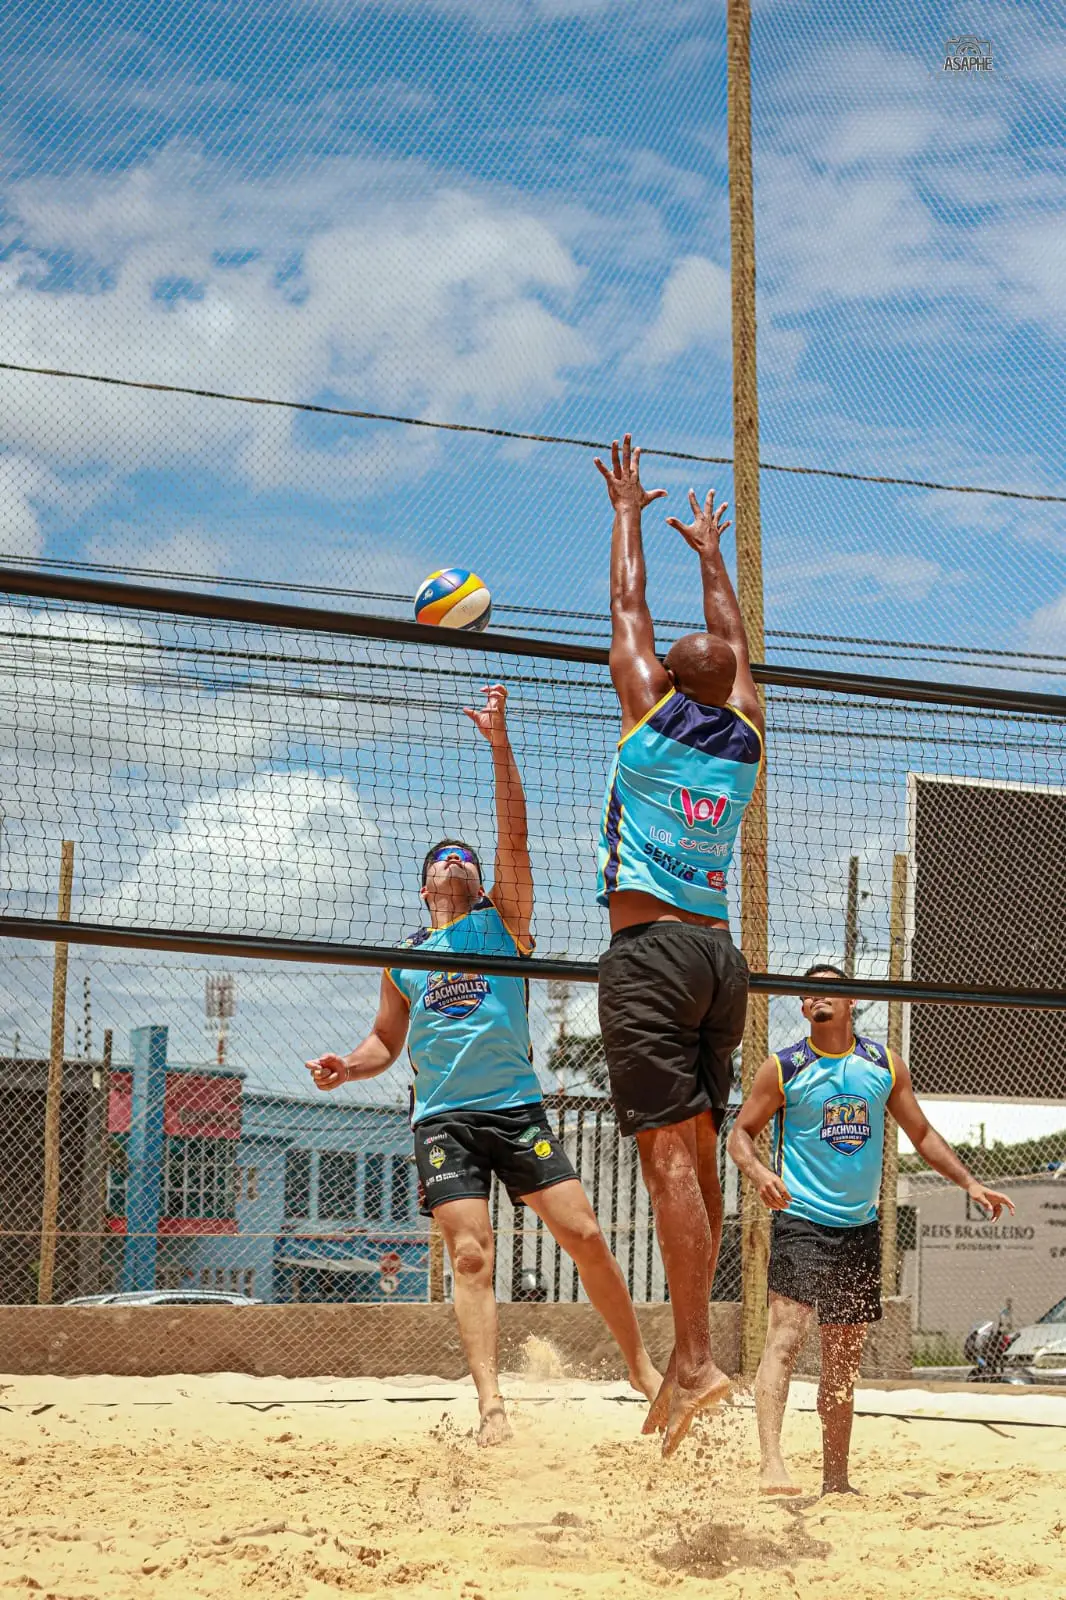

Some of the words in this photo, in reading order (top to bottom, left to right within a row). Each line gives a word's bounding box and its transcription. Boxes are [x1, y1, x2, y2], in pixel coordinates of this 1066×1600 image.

[649, 826, 676, 847] LOL
[424, 981, 488, 1007] BEACHVOLLEY
[821, 1124, 870, 1139] BEACHVOLLEY
[921, 1224, 952, 1238] REIS
